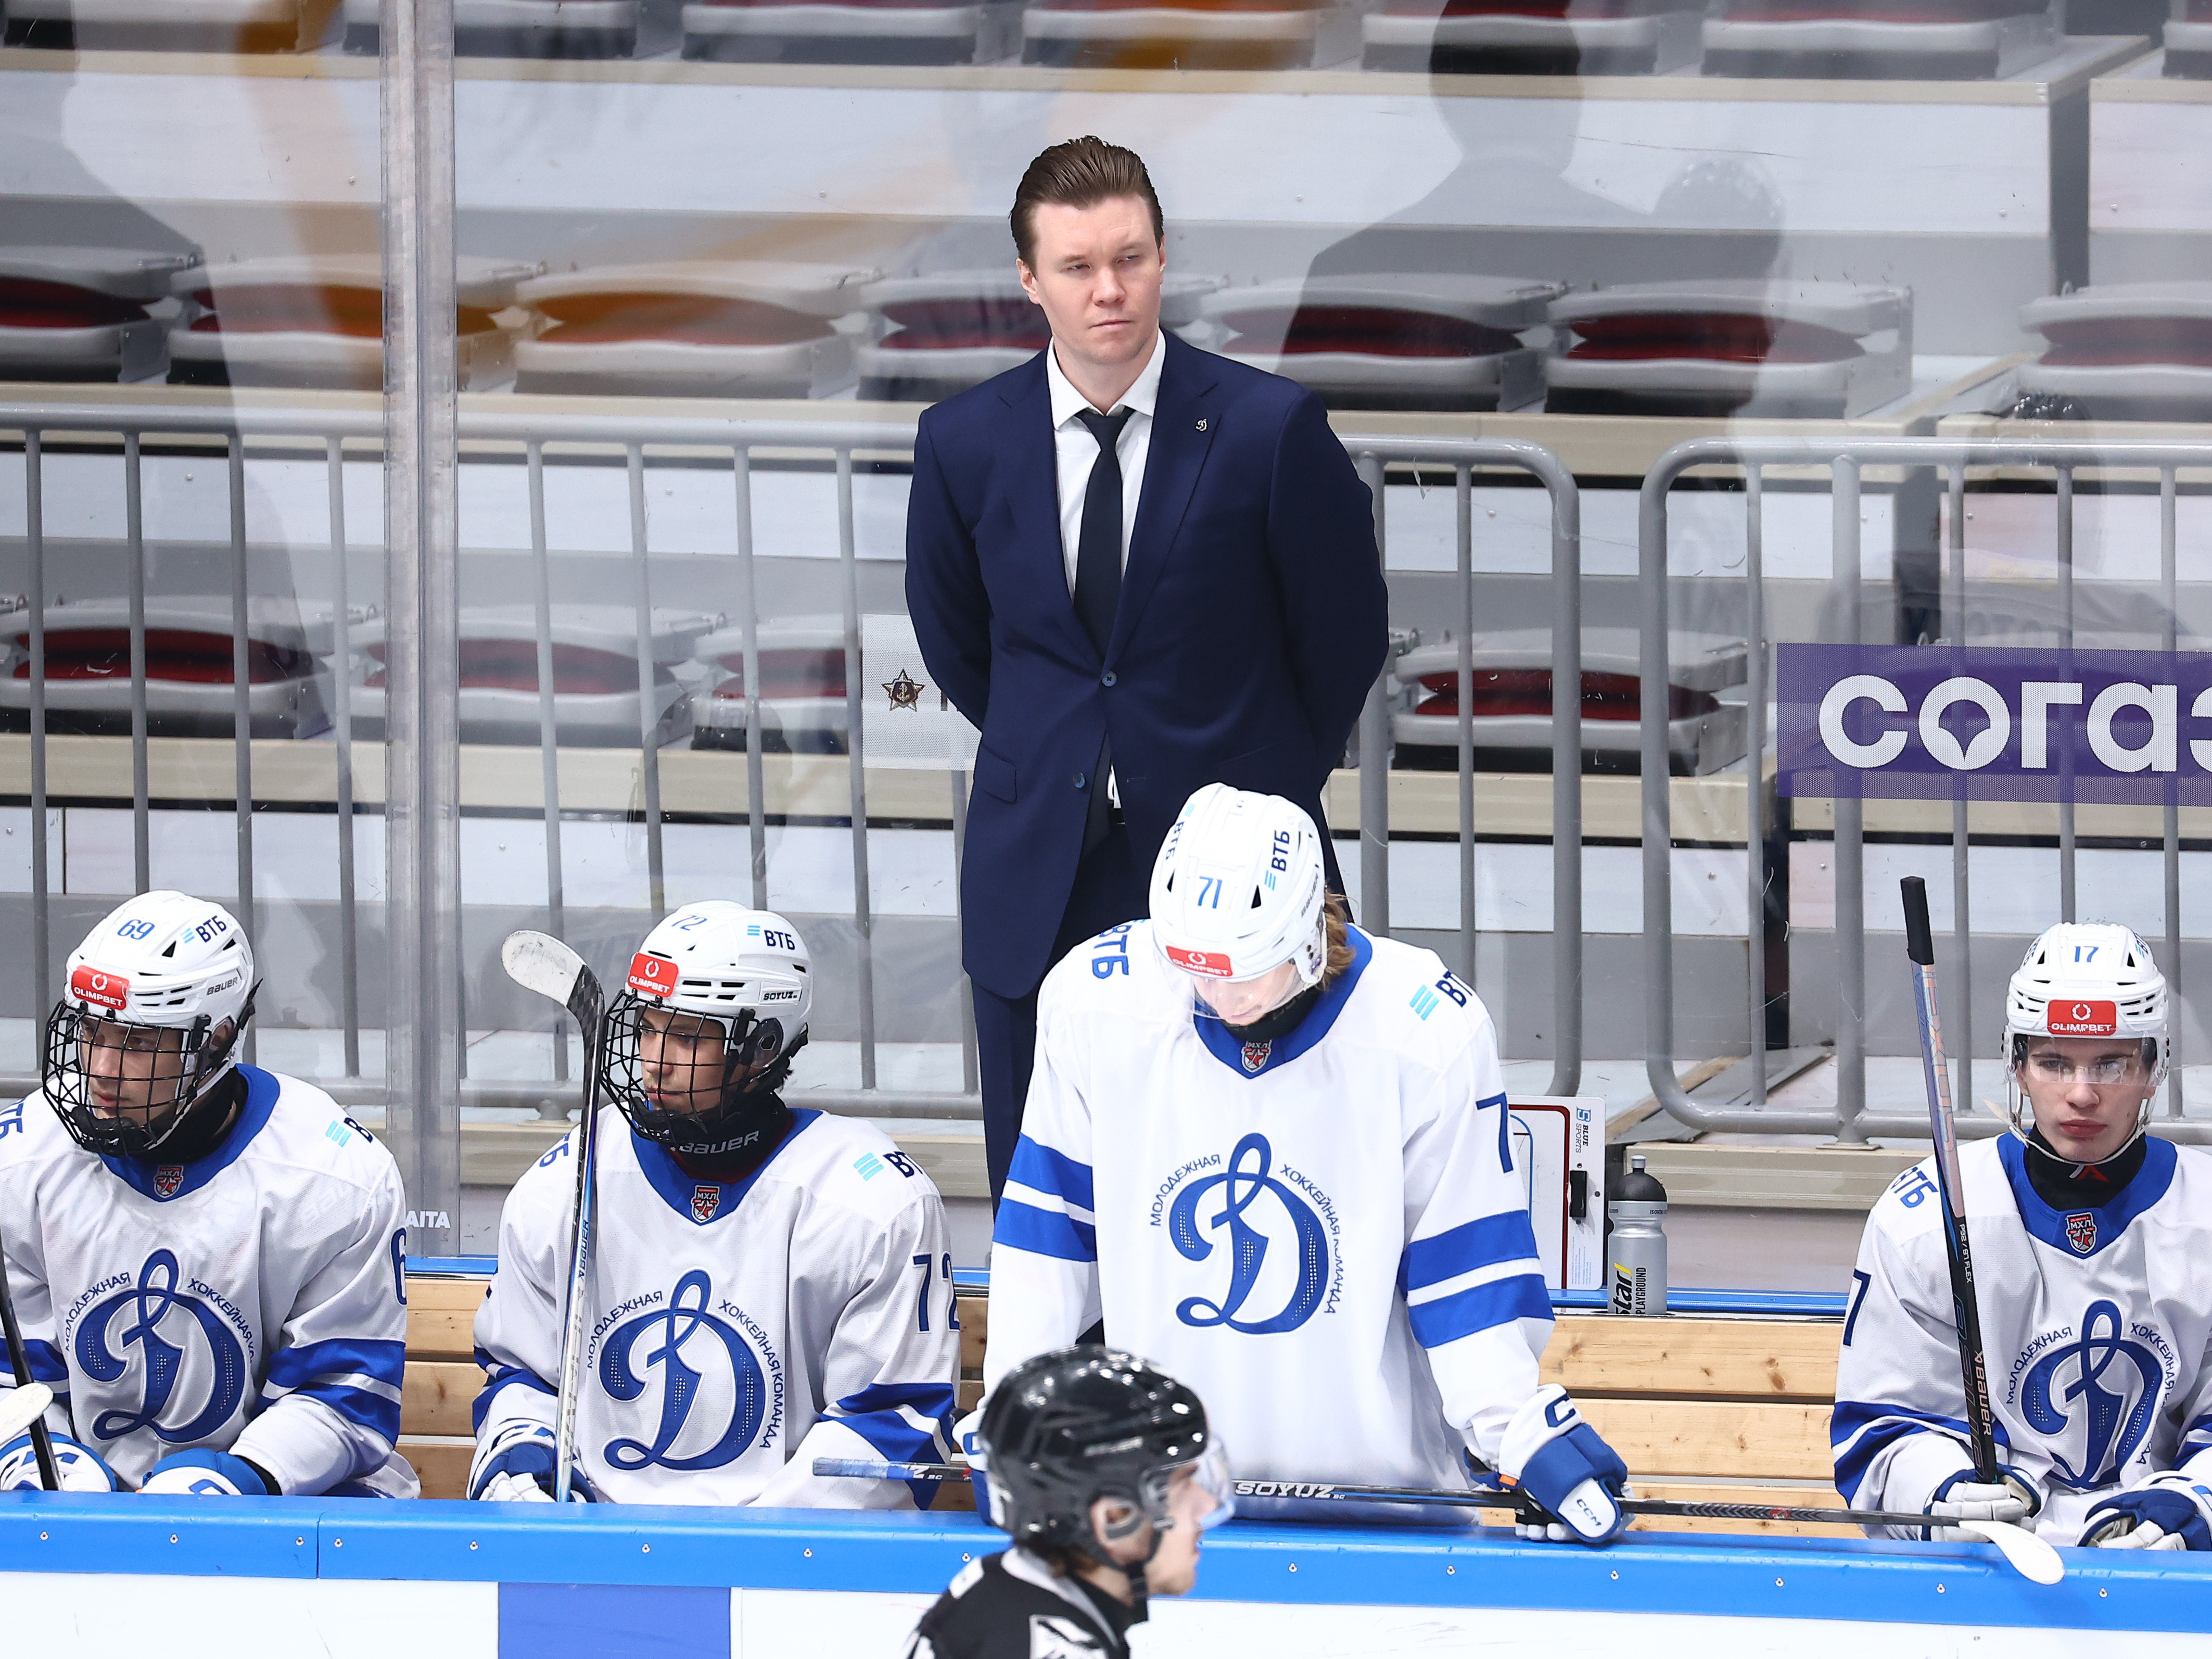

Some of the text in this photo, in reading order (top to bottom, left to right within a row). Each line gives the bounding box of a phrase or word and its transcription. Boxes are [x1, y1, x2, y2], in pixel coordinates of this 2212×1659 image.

[1819, 675, 2212, 772] сога
[1166, 821, 1185, 860] ВТБ
[1272, 829, 1290, 872] ВТБ
[1198, 876, 1223, 909] 71
[117, 919, 155, 940] 69
[195, 915, 227, 943] ВТБ
[671, 915, 707, 931] 72
[764, 930, 795, 951] ВТБ
[1092, 925, 1132, 979] ВТБ
[1172, 958, 1229, 976] OLIMPBET
[2074, 946, 2099, 963] 17
[74, 986, 123, 1007] OLIMPBET
[206, 977, 238, 996] BAUER
[630, 976, 670, 994] OLIMPBET
[763, 991, 793, 1001] SOYUZ
[1435, 970, 1473, 1008] ВТ
[2051, 1023, 2112, 1032] OLIMPBET
[679, 1130, 760, 1154] BAUER
[883, 1151, 923, 1178] ВТ
[1150, 1154, 1221, 1226] МОЛОДЕЖНАЯ
[1280, 1163, 1340, 1235] ХОККЕЙНАЯ
[1890, 1166, 1939, 1208] ВТБ
[2070, 1220, 2091, 1230] МХЛ
[912, 1252, 960, 1332] 72
[1635, 1267, 1646, 1314] PLAYGROUND
[66, 1272, 131, 1352] МОЛОДЕЖНАЯ
[187, 1278, 253, 1342] ХОККЕЙНАЯ
[587, 1290, 663, 1369] МОЛОДЕЖНАЯ
[2006, 1326, 2073, 1404] МОЛОДЕЖНАЯ
[2131, 1322, 2175, 1390] ХОККЕЙНАЯ
[718, 1299, 783, 1449] ХОККЕЙНАЯ КОМАНДА
[1975, 1363, 1993, 1436] BAUER
[1235, 1481, 1336, 1499] SOYUZ
[1577, 1499, 1602, 1527] CCM
